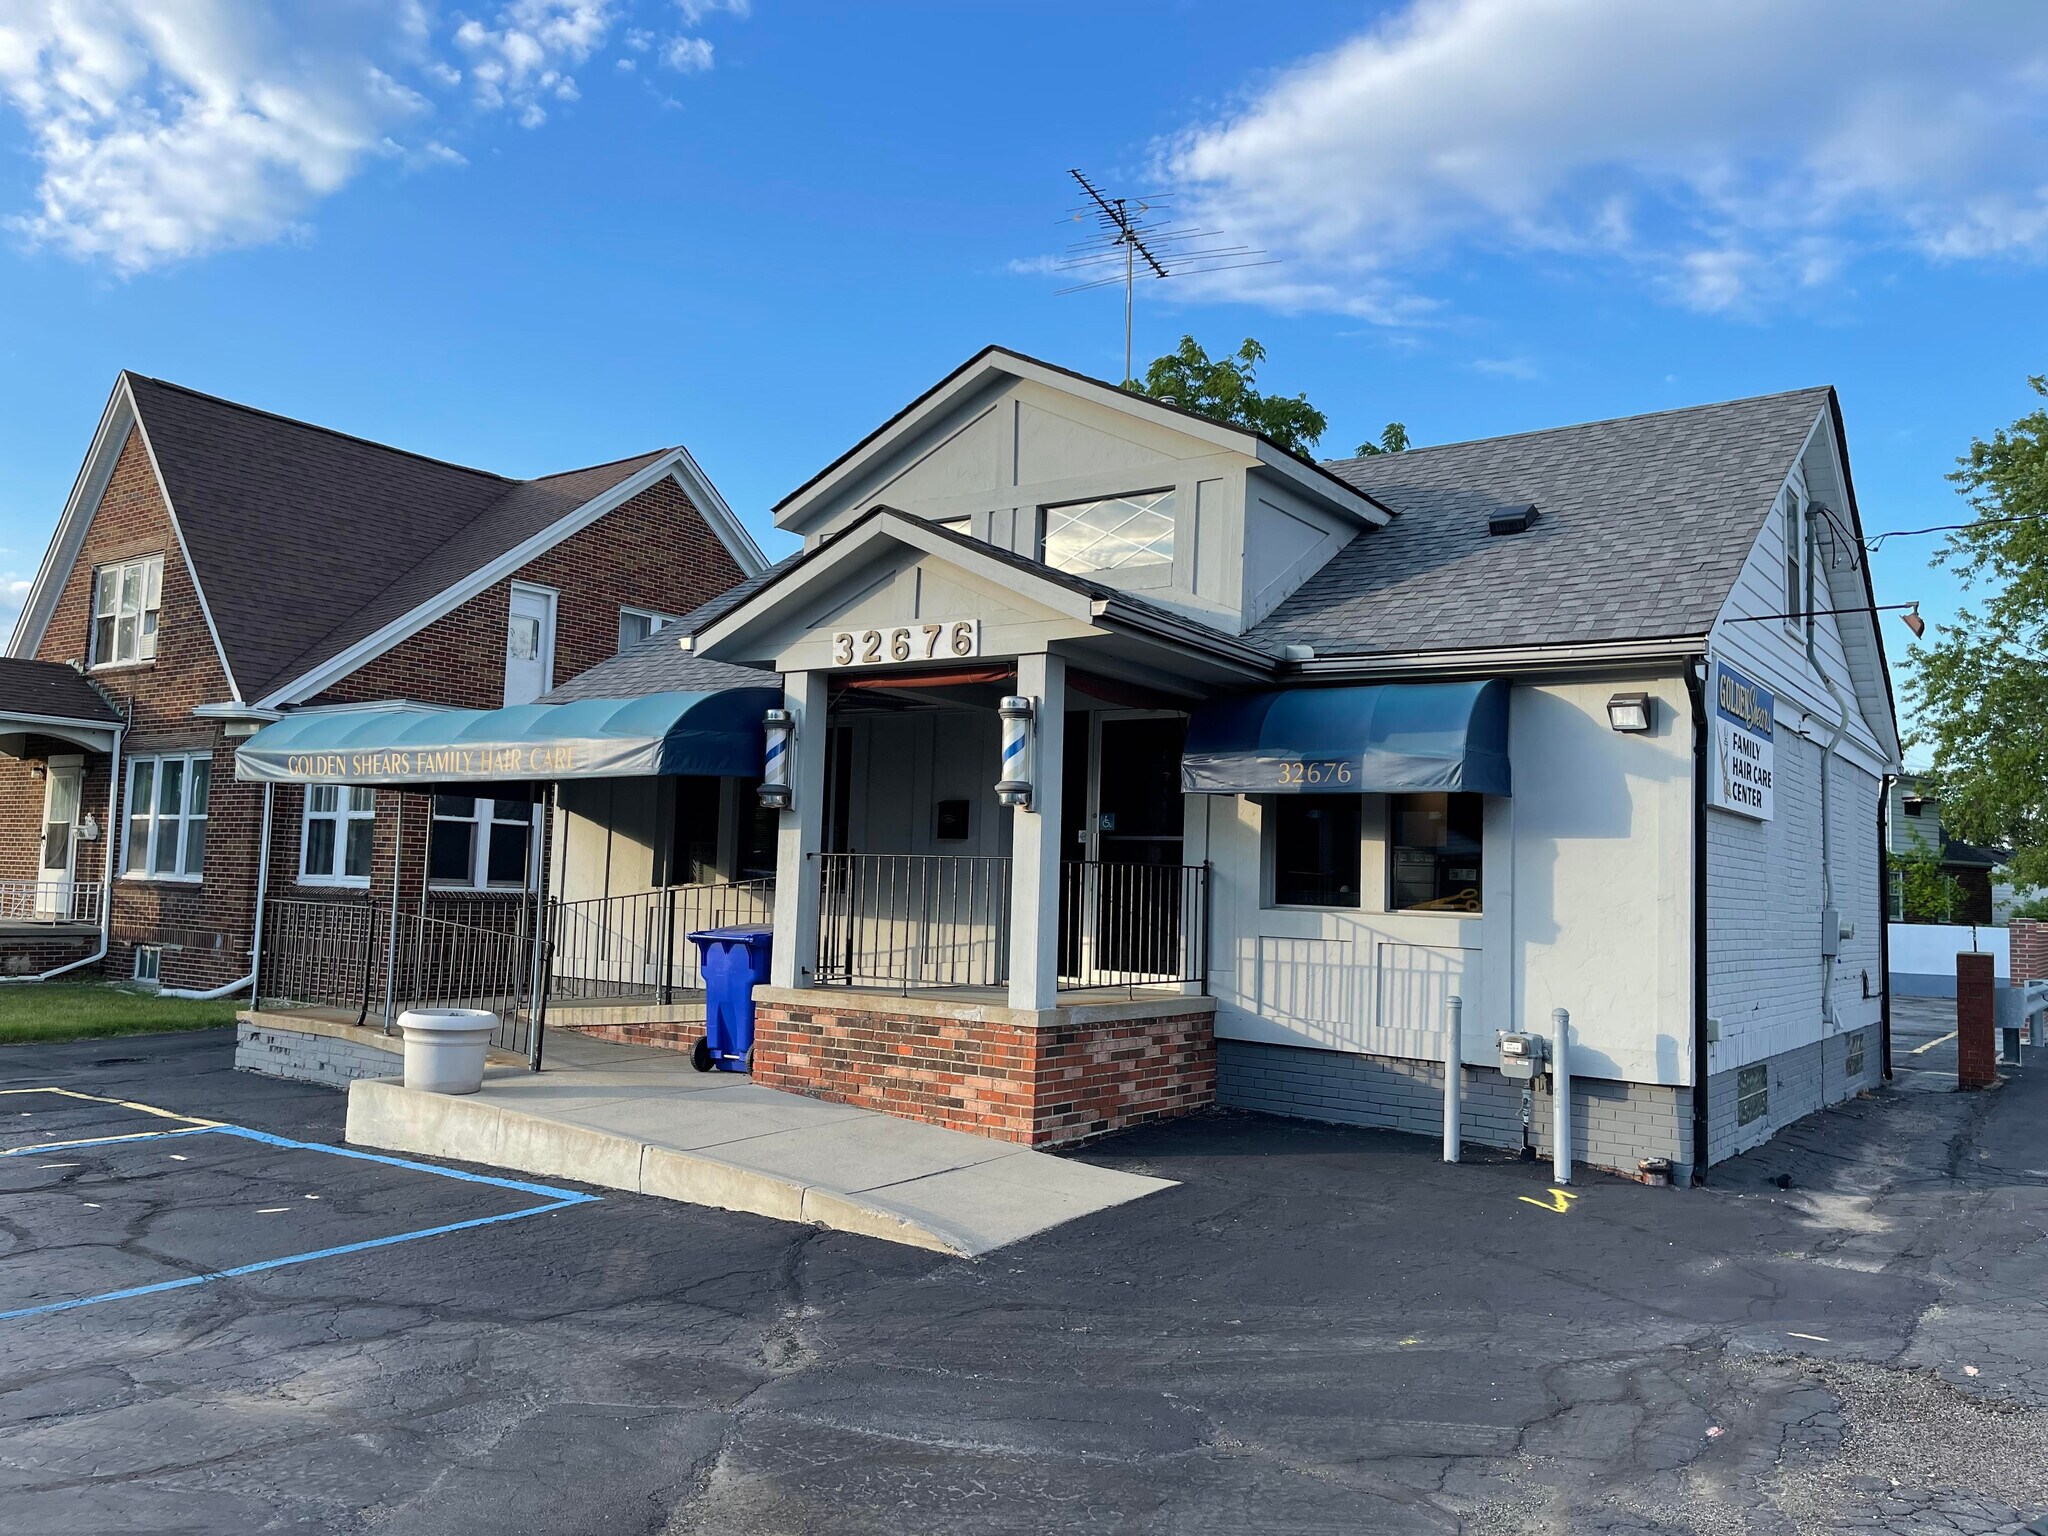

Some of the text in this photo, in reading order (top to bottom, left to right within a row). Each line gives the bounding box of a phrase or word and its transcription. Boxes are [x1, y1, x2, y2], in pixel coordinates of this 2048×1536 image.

[835, 621, 972, 665] 32676
[1719, 673, 1751, 725] GOLDEN
[288, 747, 578, 776] GOLDEN SHEARS FAMILY HAIR CARE
[1732, 732, 1762, 762] FAMILY
[1278, 762, 1352, 784] 32676
[1732, 756, 1772, 789] HAIR CARE
[1732, 781, 1762, 809] CENTER
